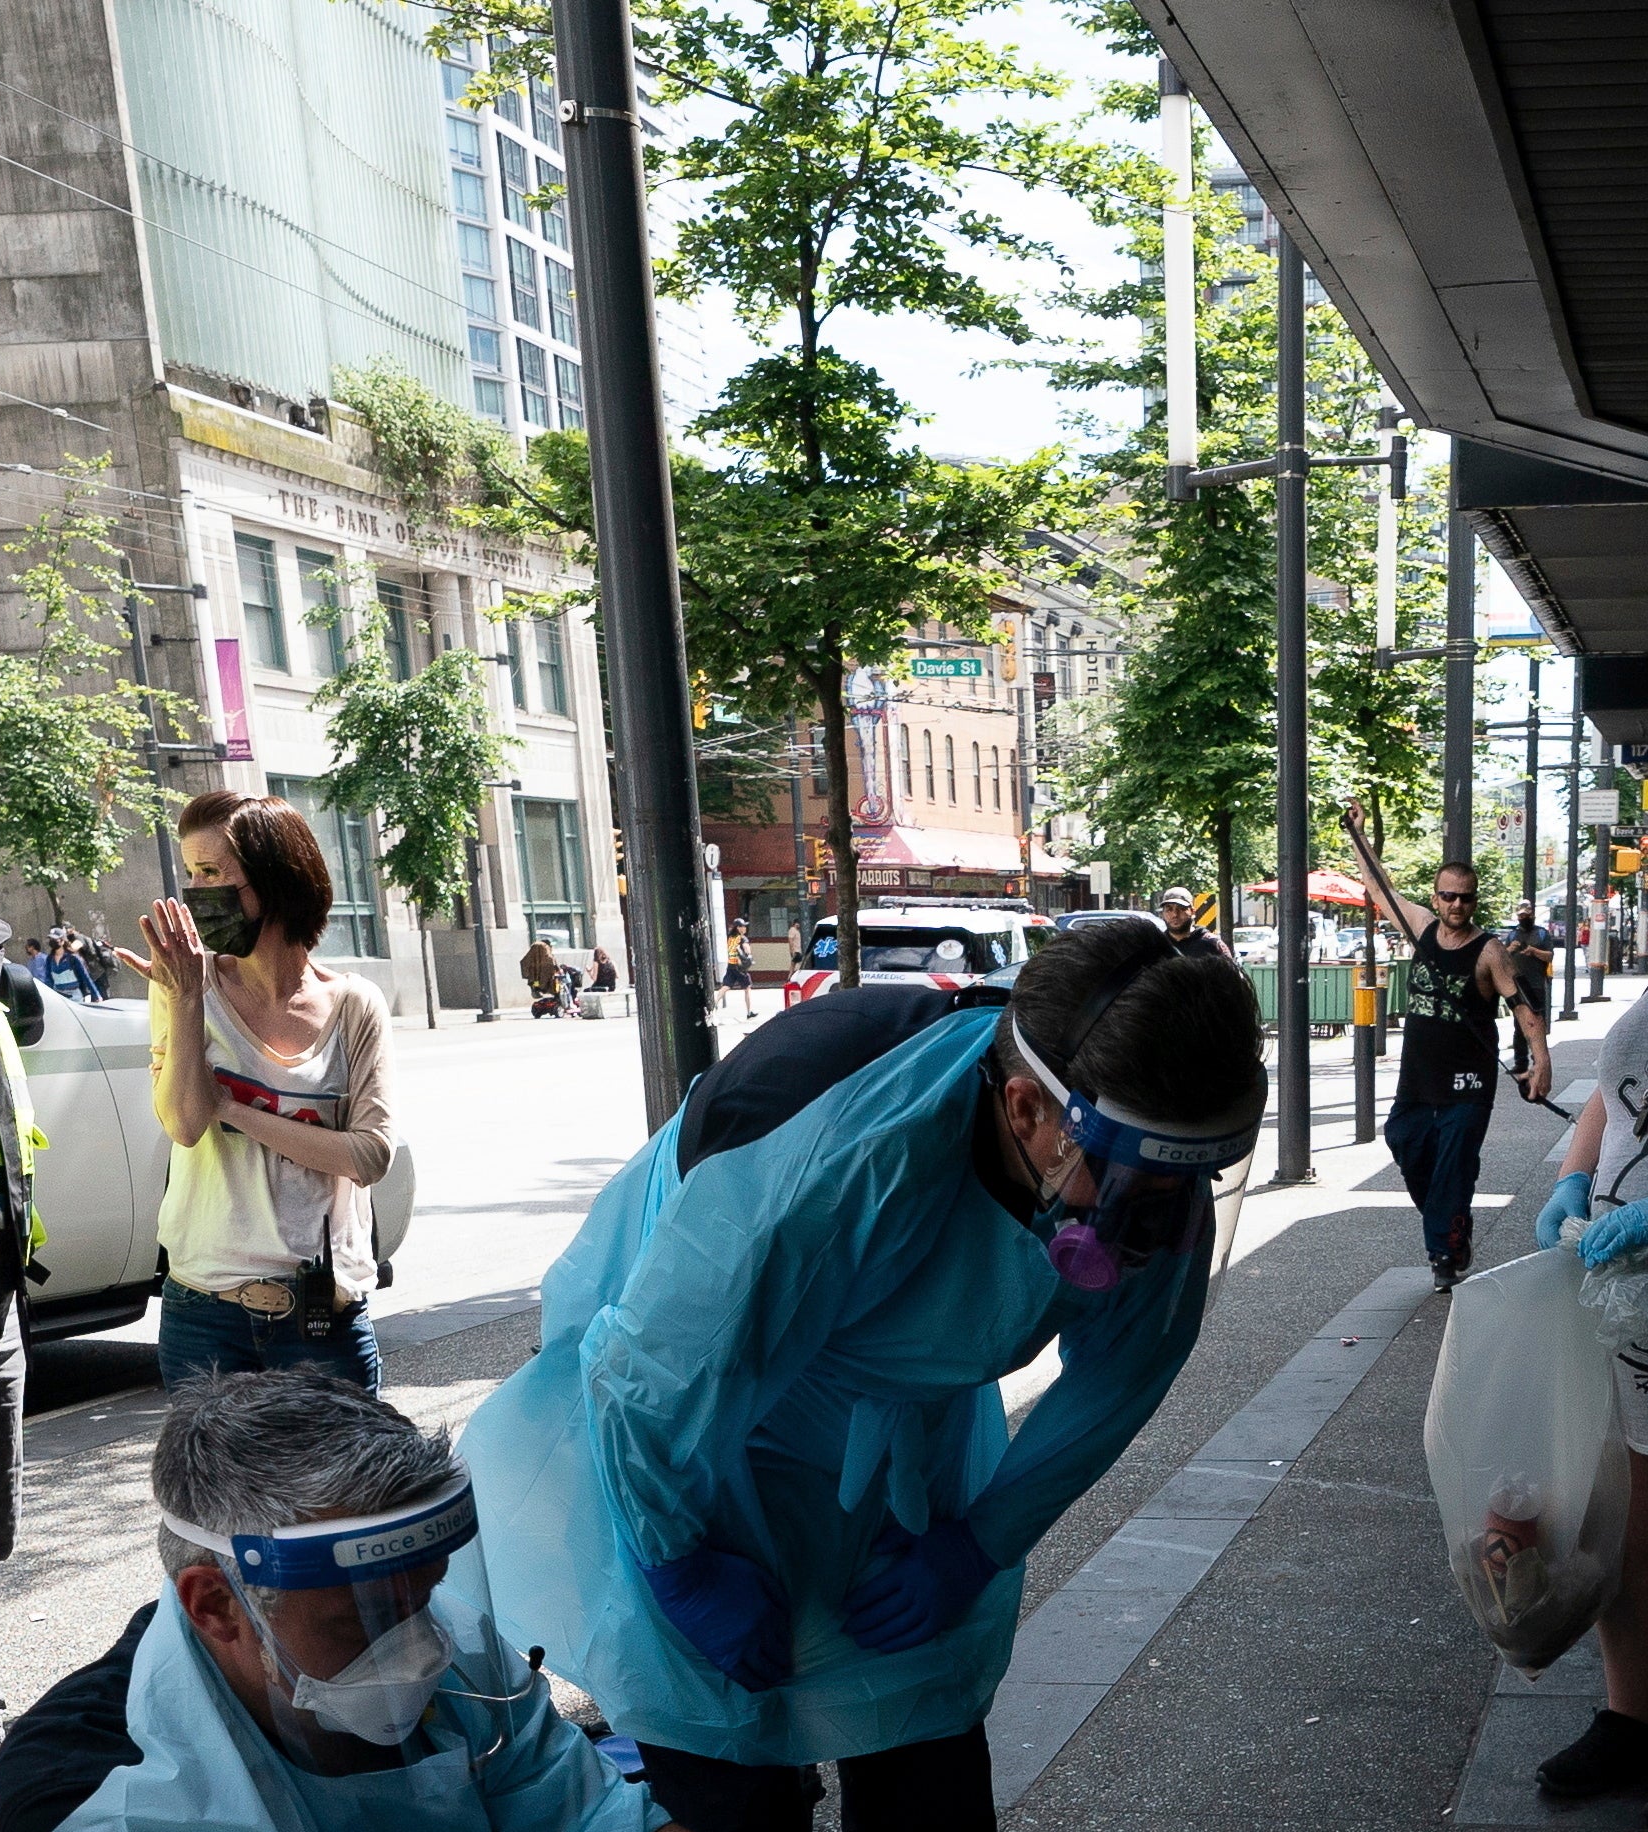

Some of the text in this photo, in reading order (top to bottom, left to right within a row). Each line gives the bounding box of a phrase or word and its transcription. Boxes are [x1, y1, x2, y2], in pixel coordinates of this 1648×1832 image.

[336, 505, 380, 538] BANK
[916, 661, 977, 675] Davie St
[860, 973, 906, 981] ARAMEDIC
[1453, 1072, 1483, 1090] 5%
[1157, 1144, 1210, 1161] Face
[355, 1500, 472, 1560] Face Shield
